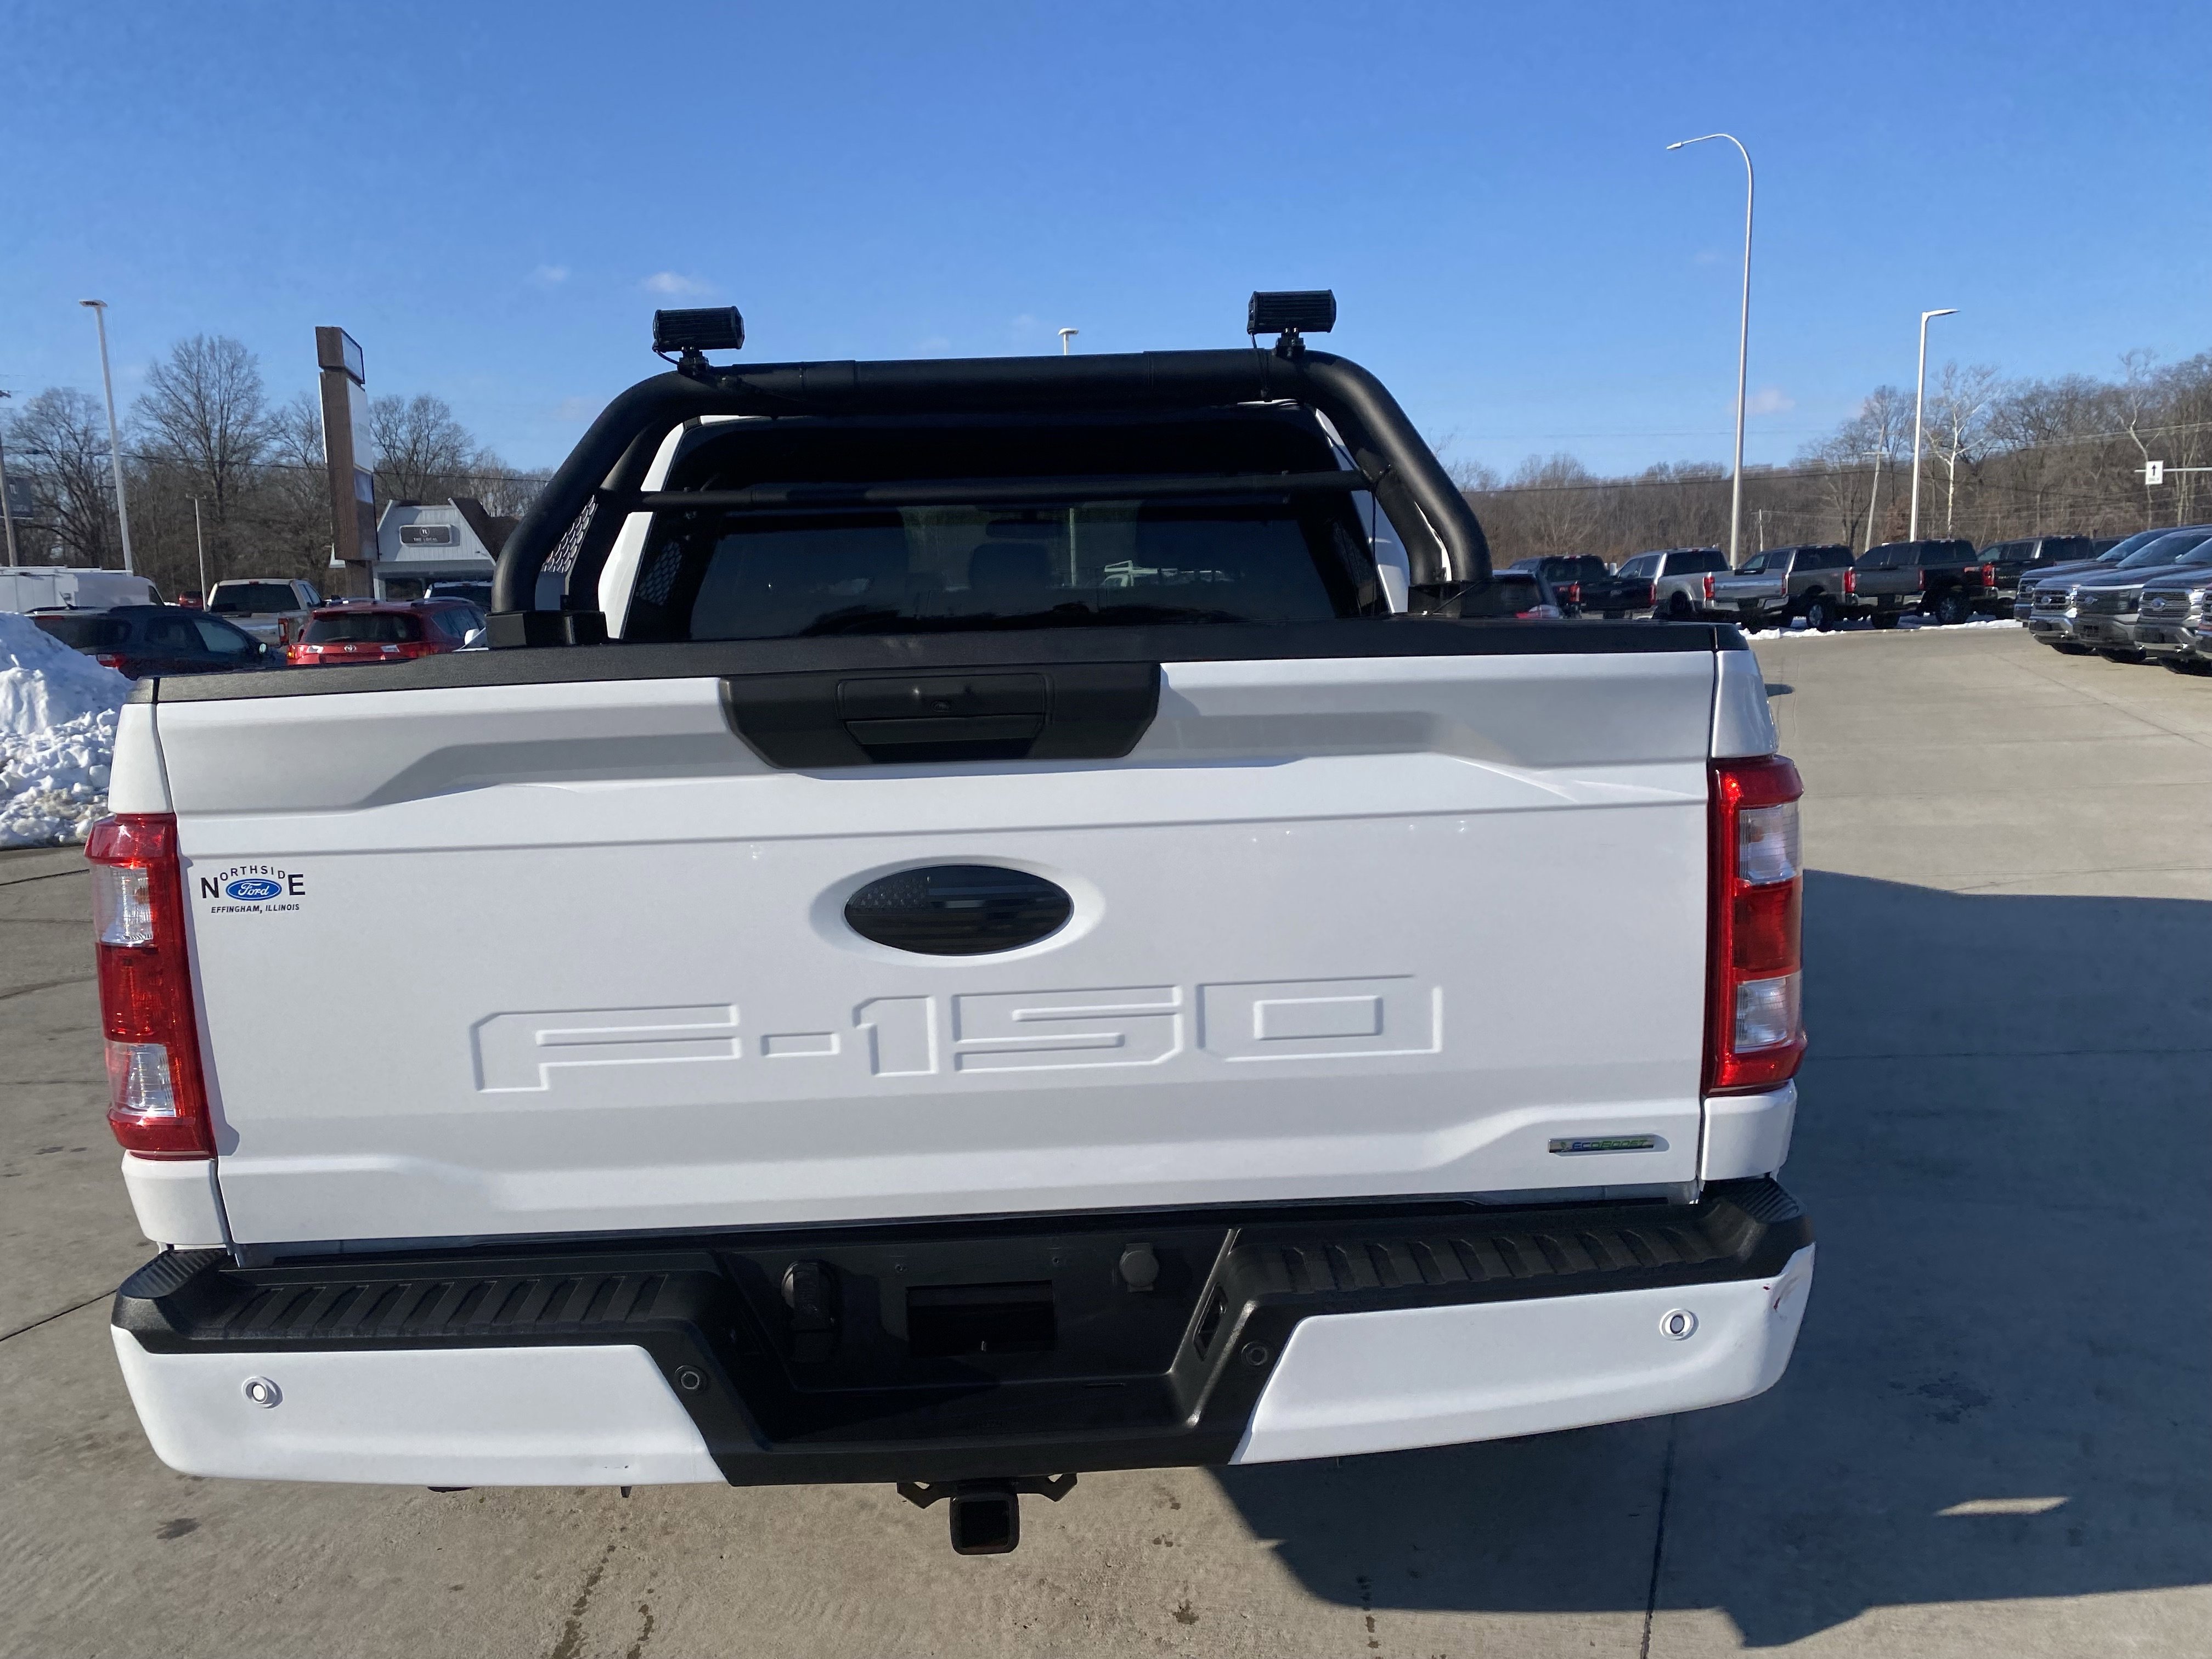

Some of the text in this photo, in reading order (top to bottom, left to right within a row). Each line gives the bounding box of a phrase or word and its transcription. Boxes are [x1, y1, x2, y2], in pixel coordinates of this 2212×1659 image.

[200, 865, 306, 899] NORTHSIDE
[238, 882, 269, 896] Ford
[211, 905, 263, 913] EFFINGHAM,
[469, 974, 1443, 1093] F-150
